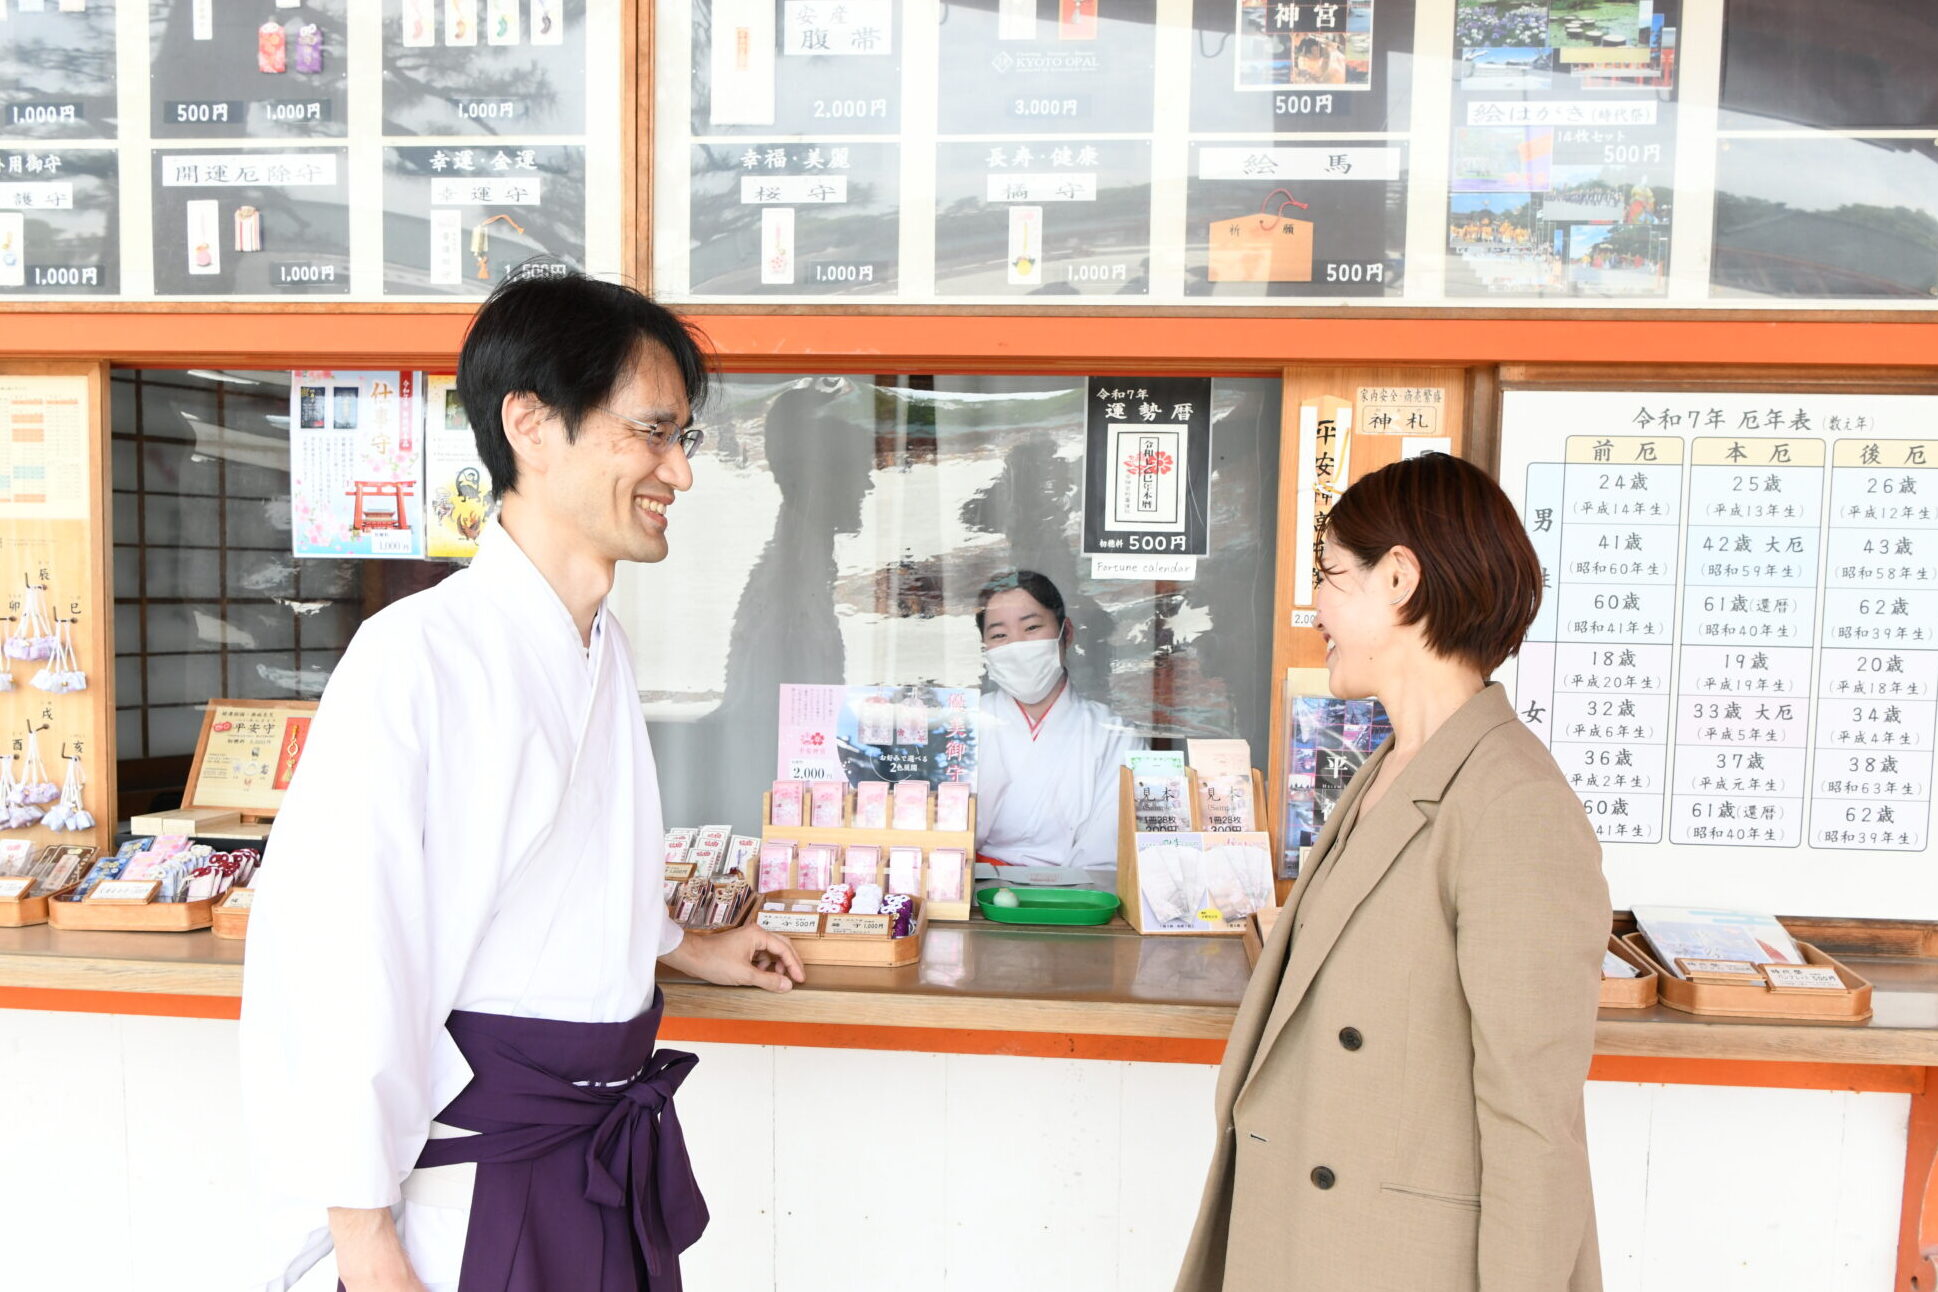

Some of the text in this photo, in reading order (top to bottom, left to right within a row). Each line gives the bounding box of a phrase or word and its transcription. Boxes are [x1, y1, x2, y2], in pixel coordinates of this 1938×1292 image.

[1274, 3, 1339, 28] 神宮
[800, 28, 881, 51] 腹帯
[1016, 57, 1100, 68] KYOTO OPAL
[177, 103, 229, 122] 500円
[266, 103, 321, 120] 1,000円
[458, 102, 514, 119] 1,000円
[813, 100, 887, 119] 2,000円
[1015, 99, 1078, 116] 3,000円
[1275, 94, 1333, 114] 500円
[1473, 103, 1585, 123] 絵はがき
[12, 105, 75, 123] 1,000円
[428, 150, 538, 172] 幸運・金運
[739, 147, 851, 169] 幸福・美麗
[985, 147, 1100, 168] 長寿・健康
[1604, 144, 1661, 163] 500円
[1243, 153, 1353, 175] 絵馬
[175, 164, 323, 184] 開運厄除守
[440, 185, 529, 202] 幸運守
[755, 184, 837, 202] 桜守
[35, 267, 98, 285] 1,000円
[281, 264, 335, 281] 1,000円
[816, 265, 873, 281] 1,000円
[1068, 264, 1126, 281] 1,000円
[1326, 263, 1383, 282] 500円
[1096, 387, 1149, 400] 令和7年
[1105, 402, 1194, 422] 運勢暦
[1368, 411, 1429, 431] 神札
[1632, 406, 1725, 430] 令和7年
[1737, 407, 1812, 431] 厄年表
[1592, 438, 1658, 462] 前厄
[1725, 441, 1792, 464] 本厄
[1859, 442, 1927, 465] 後厄
[1599, 471, 1649, 491] 24歳
[1732, 473, 1782, 493] 25歳
[1867, 475, 1917, 494] 26歳
[1573, 501, 1671, 516] (平成14年生)
[1706, 503, 1804, 518] (平成13年生)
[1128, 535, 1187, 551] 500円
[1598, 531, 1643, 551] 41歳
[1703, 533, 1804, 553] 42歳 大厄
[1863, 536, 1913, 556] 43歳
[1097, 561, 1138, 573] Fortune
[1569, 561, 1668, 576] (昭和60年生)
[1701, 563, 1803, 578] (昭和59年生)
[1834, 565, 1937, 581] (昭和58年生)
[1594, 591, 1640, 611] 60歳
[1704, 594, 1797, 614] 61歳(還暦)
[1859, 596, 1909, 616] 62歳
[1294, 614, 1316, 624] 2.00
[1567, 621, 1664, 636] (昭和41年生)
[1698, 623, 1797, 639] (昭和40年生)
[1831, 625, 1933, 641] (昭和39年生)
[1593, 648, 1637, 668] 18歳
[1725, 651, 1769, 671] 19歳
[1857, 654, 1905, 673] 20歳
[1563, 674, 1662, 690] (平成20年生)
[1696, 676, 1794, 692] (平成19年生)
[1828, 679, 1928, 696] (平成18年生)
[1521, 700, 1546, 724] 女
[1587, 698, 1636, 718] 32歳
[1694, 701, 1793, 720] 33歳 大厄
[1852, 705, 1902, 724] 34歳
[1566, 724, 1654, 739] (平成6年生)
[1697, 727, 1786, 743] (平成5年生)
[1830, 730, 1920, 746] (平成4年生)
[1584, 747, 1633, 767] 36歳
[1716, 751, 1765, 771] 37歳
[1849, 754, 1898, 774] 38歳
[1691, 776, 1786, 792] (平成元年生)
[1821, 780, 1922, 796] (昭和63年生)
[1143, 786, 1175, 802] 見本
[1692, 800, 1784, 820] 61歳(還暦)
[1845, 805, 1895, 824] 62歳
[1596, 823, 1652, 839] 41年生)
[1686, 826, 1785, 842] (昭和40年生)
[1817, 830, 1919, 845] (昭和39年生)
